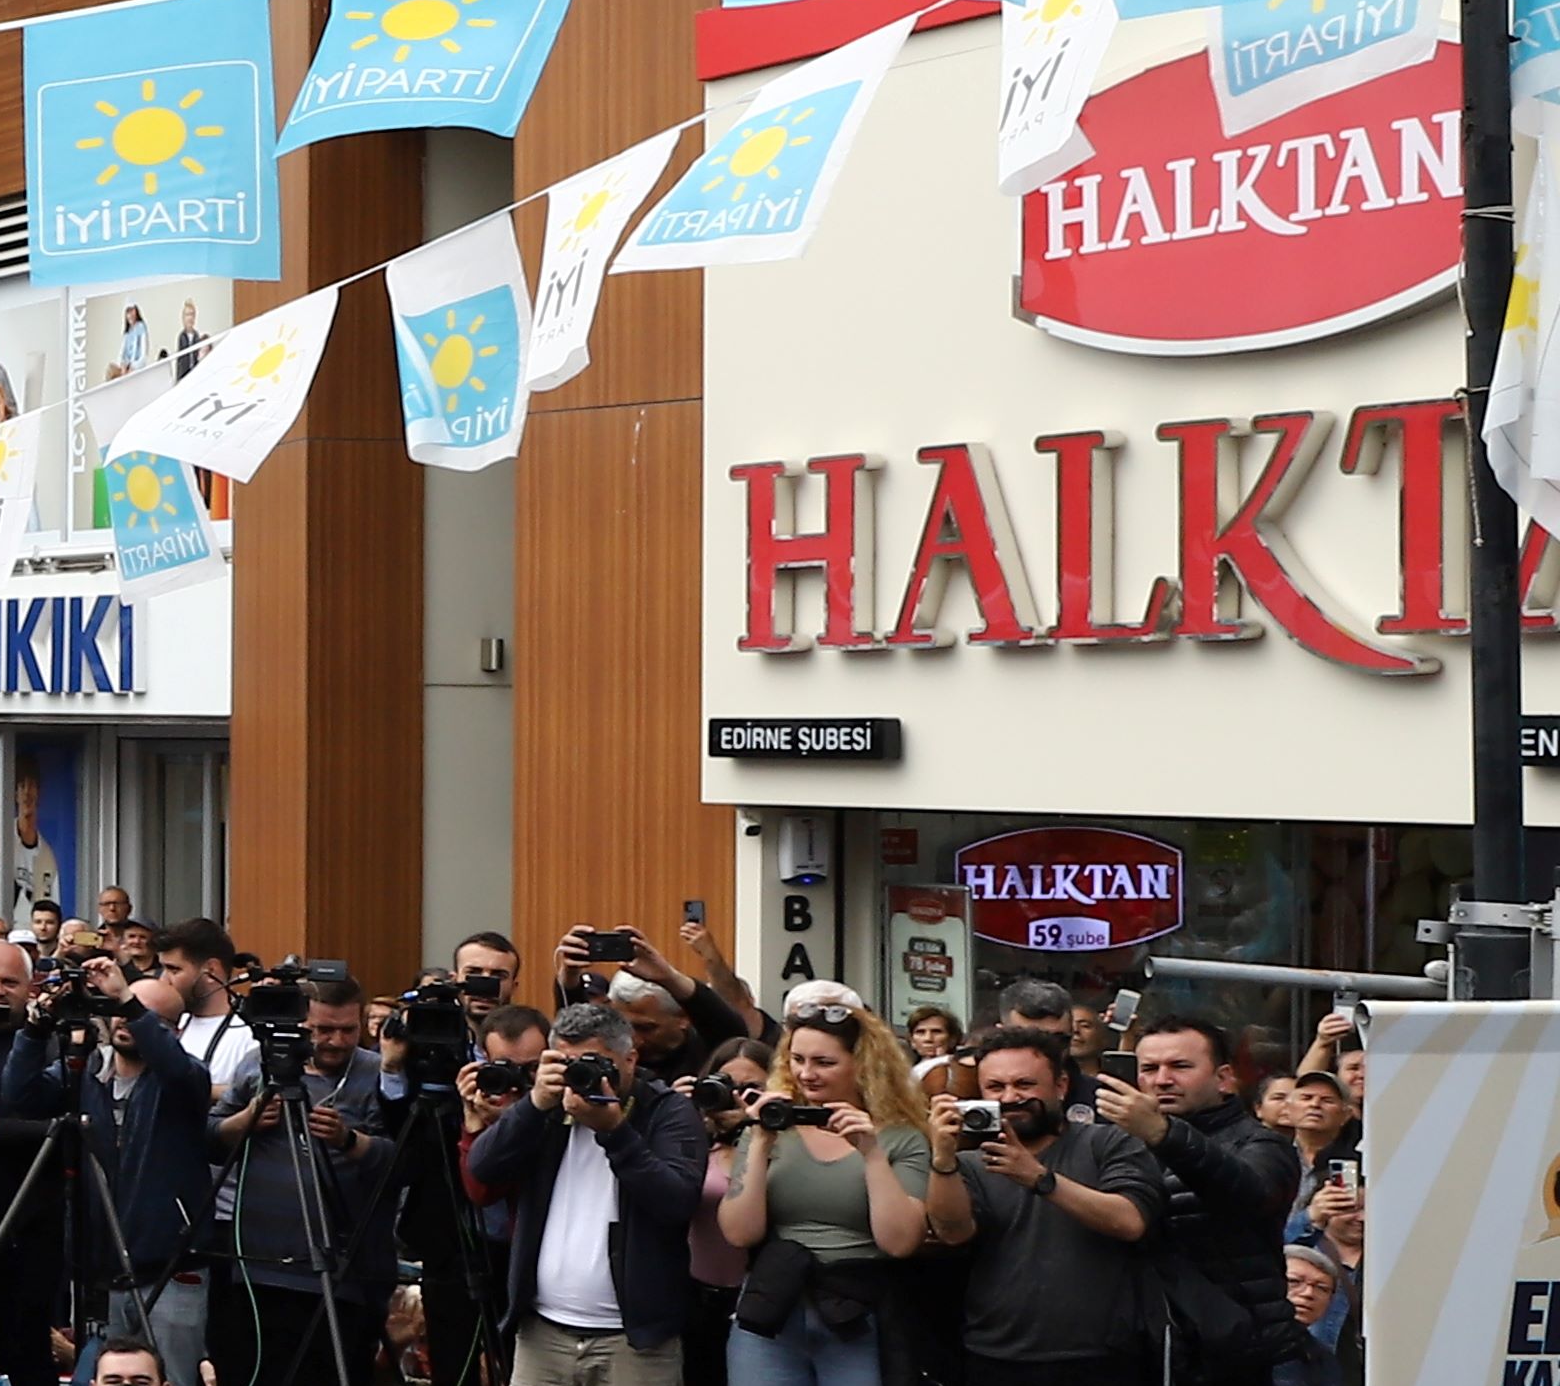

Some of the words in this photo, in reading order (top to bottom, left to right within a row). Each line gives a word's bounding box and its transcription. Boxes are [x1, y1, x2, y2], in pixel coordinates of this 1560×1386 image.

[358, 64, 495, 99] PARTİ
[1036, 110, 1464, 261] HALKTAN
[56, 199, 110, 246] İYİ
[121, 191, 245, 237] PARTİ
[720, 721, 792, 750] EDİRNE
[798, 721, 871, 755] ŞUBESİ
[962, 863, 1172, 905] HALKTAN
[1033, 924, 1062, 947] 59
[1066, 928, 1106, 947] şube
